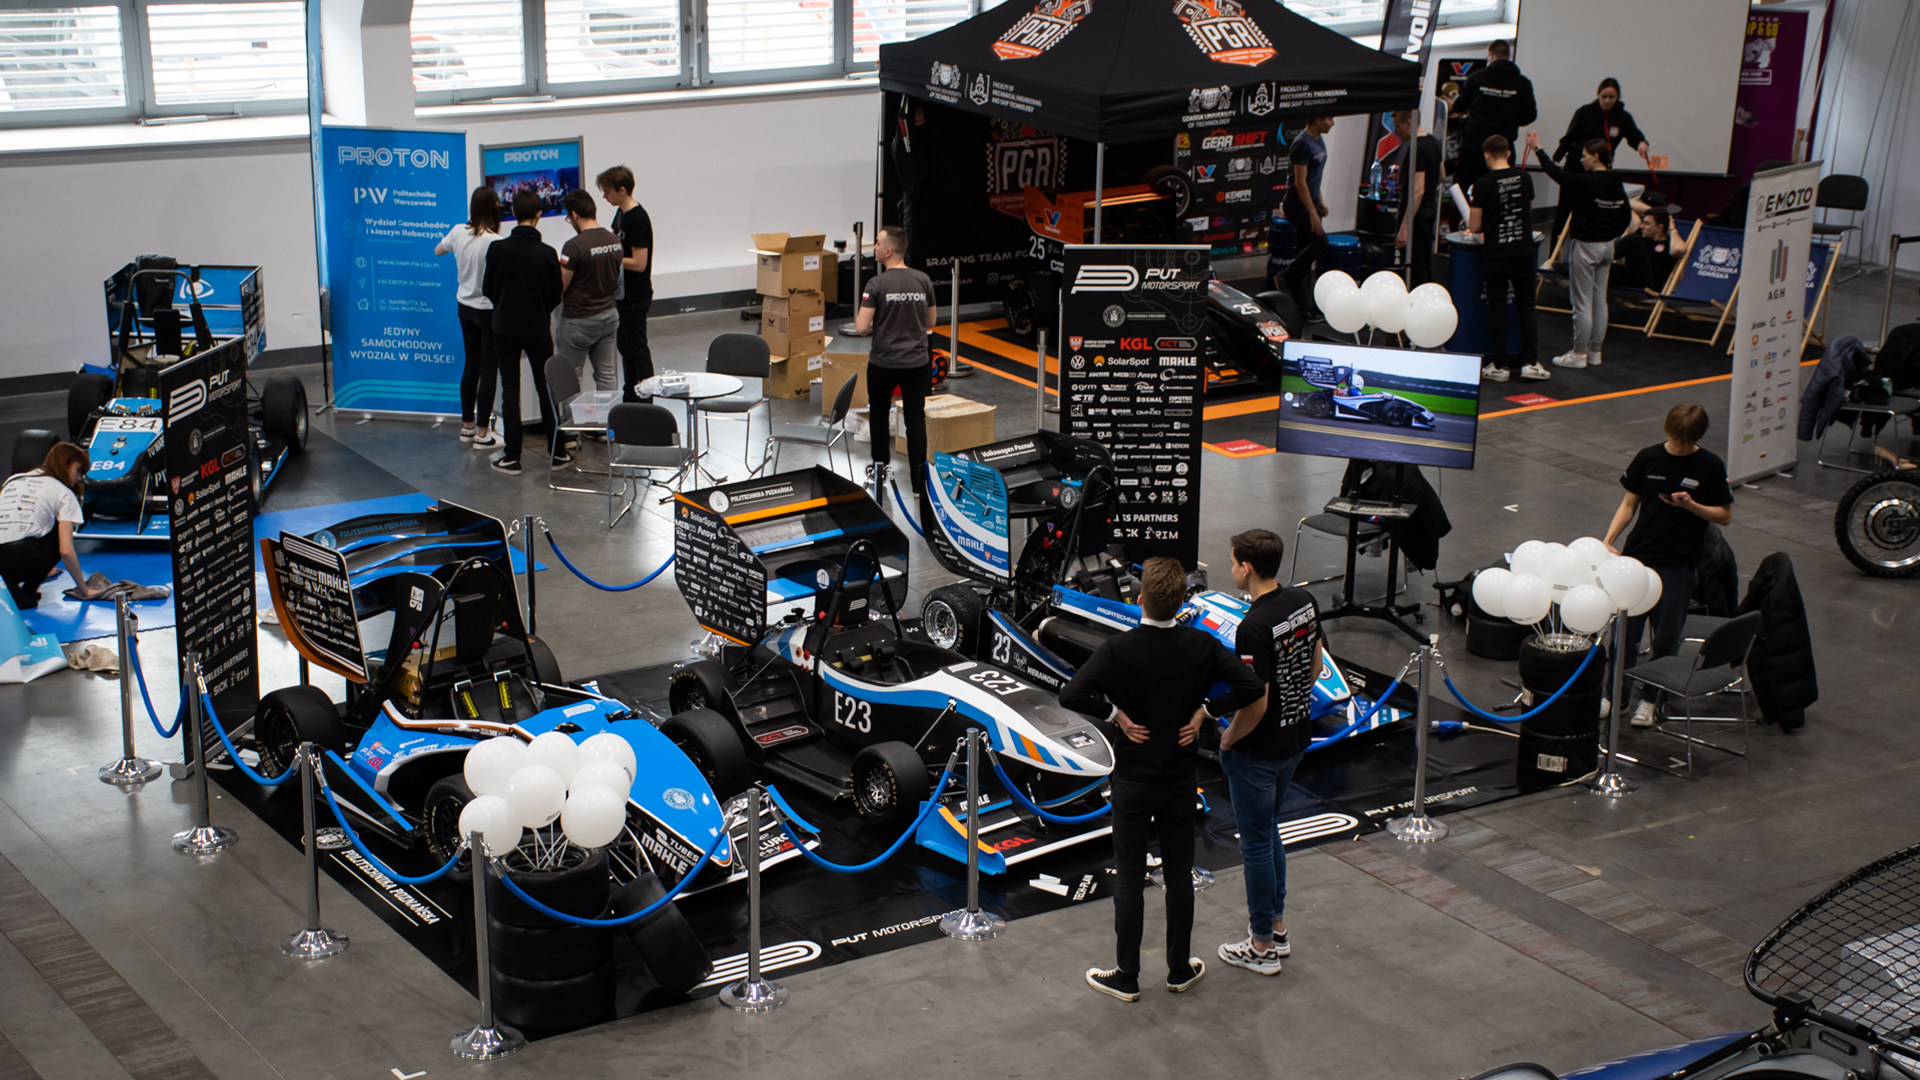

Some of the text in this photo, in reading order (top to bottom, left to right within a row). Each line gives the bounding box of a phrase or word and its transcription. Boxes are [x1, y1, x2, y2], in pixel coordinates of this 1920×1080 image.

[1014, 18, 1059, 47] PGR
[1201, 19, 1258, 52] PGR
[1314, 89, 1348, 98] ENGINEERING
[1196, 118, 1231, 127] TECHNOLOGY
[1202, 135, 1233, 150] GEAR
[1234, 131, 1268, 146] SHIFT
[338, 146, 449, 169] PROTON
[504, 149, 559, 164] PROTON
[1003, 147, 1051, 190] PGR
[354, 187, 388, 204] PW
[393, 189, 436, 198] Politechnika
[1765, 187, 1813, 213] E-MOTO
[393, 198, 436, 207] Warszawska
[365, 217, 450, 229] Wydział Samochodów
[371, 228, 400, 238] Maszyn
[401, 229, 444, 241] Roboczych
[1029, 235, 1045, 260] 25
[978, 251, 1012, 263] TEAM
[1145, 268, 1181, 280] PUT
[1692, 261, 1738, 275] POLITECHNIKA
[1697, 270, 1729, 279] GDAŃSKA
[1141, 281, 1200, 290] MOTORSPORT
[886, 292, 926, 302] PROTON
[1767, 288, 1786, 301] AGH
[1233, 302, 1261, 315] 25
[383, 327, 420, 337] JEDYNY
[361, 338, 443, 351] SAMOCHODOWY
[1120, 337, 1153, 350] KGL
[1160, 340, 1178, 348] KCT
[350, 350, 455, 364] WYDZIAŁ W POLSCE!
[1108, 356, 1198, 367] SolarSpot MAHLE
[210, 369, 230, 390] PUT
[1137, 371, 1157, 379] Ansys
[209, 379, 241, 402] MOTORSPORT
[100, 419, 157, 431] E84
[981, 444, 1013, 458] Volkswagen
[1014, 441, 1034, 452] Poznań
[90, 460, 125, 471] E84
[201, 458, 220, 479] KGL
[196, 464, 247, 500] SolarSpot MAHLE
[730, 486, 794, 503] POLITECHNIKA POZNAŃSKA
[690, 511, 718, 529] SolarSpot
[1133, 514, 1178, 522] PARTNERS
[339, 518, 418, 538] POLITECHNIKA POZNAŃSKA
[697, 526, 717, 540] Ansys
[957, 535, 984, 552] MAHLE
[299, 564, 349, 594] TUBES MAHLE
[1096, 606, 1139, 626] PROFITECHNIK
[992, 632, 1012, 664] 23
[223, 648, 249, 671] PARTNERS
[969, 670, 1026, 696] E23
[1027, 665, 1059, 687] MERAMONT
[213, 679, 228, 696] SICK
[834, 691, 872, 734] E23
[366, 755, 385, 771] KGL
[1364, 786, 1478, 817] PUT MOORSPORT
[670, 838, 700, 862] TUBES
[993, 837, 1036, 852] KGL
[641, 832, 688, 875] MAHLE
[341, 849, 440, 925] POLITECHNIKA POZNAŃSKA
[831, 932, 868, 947] PUT
